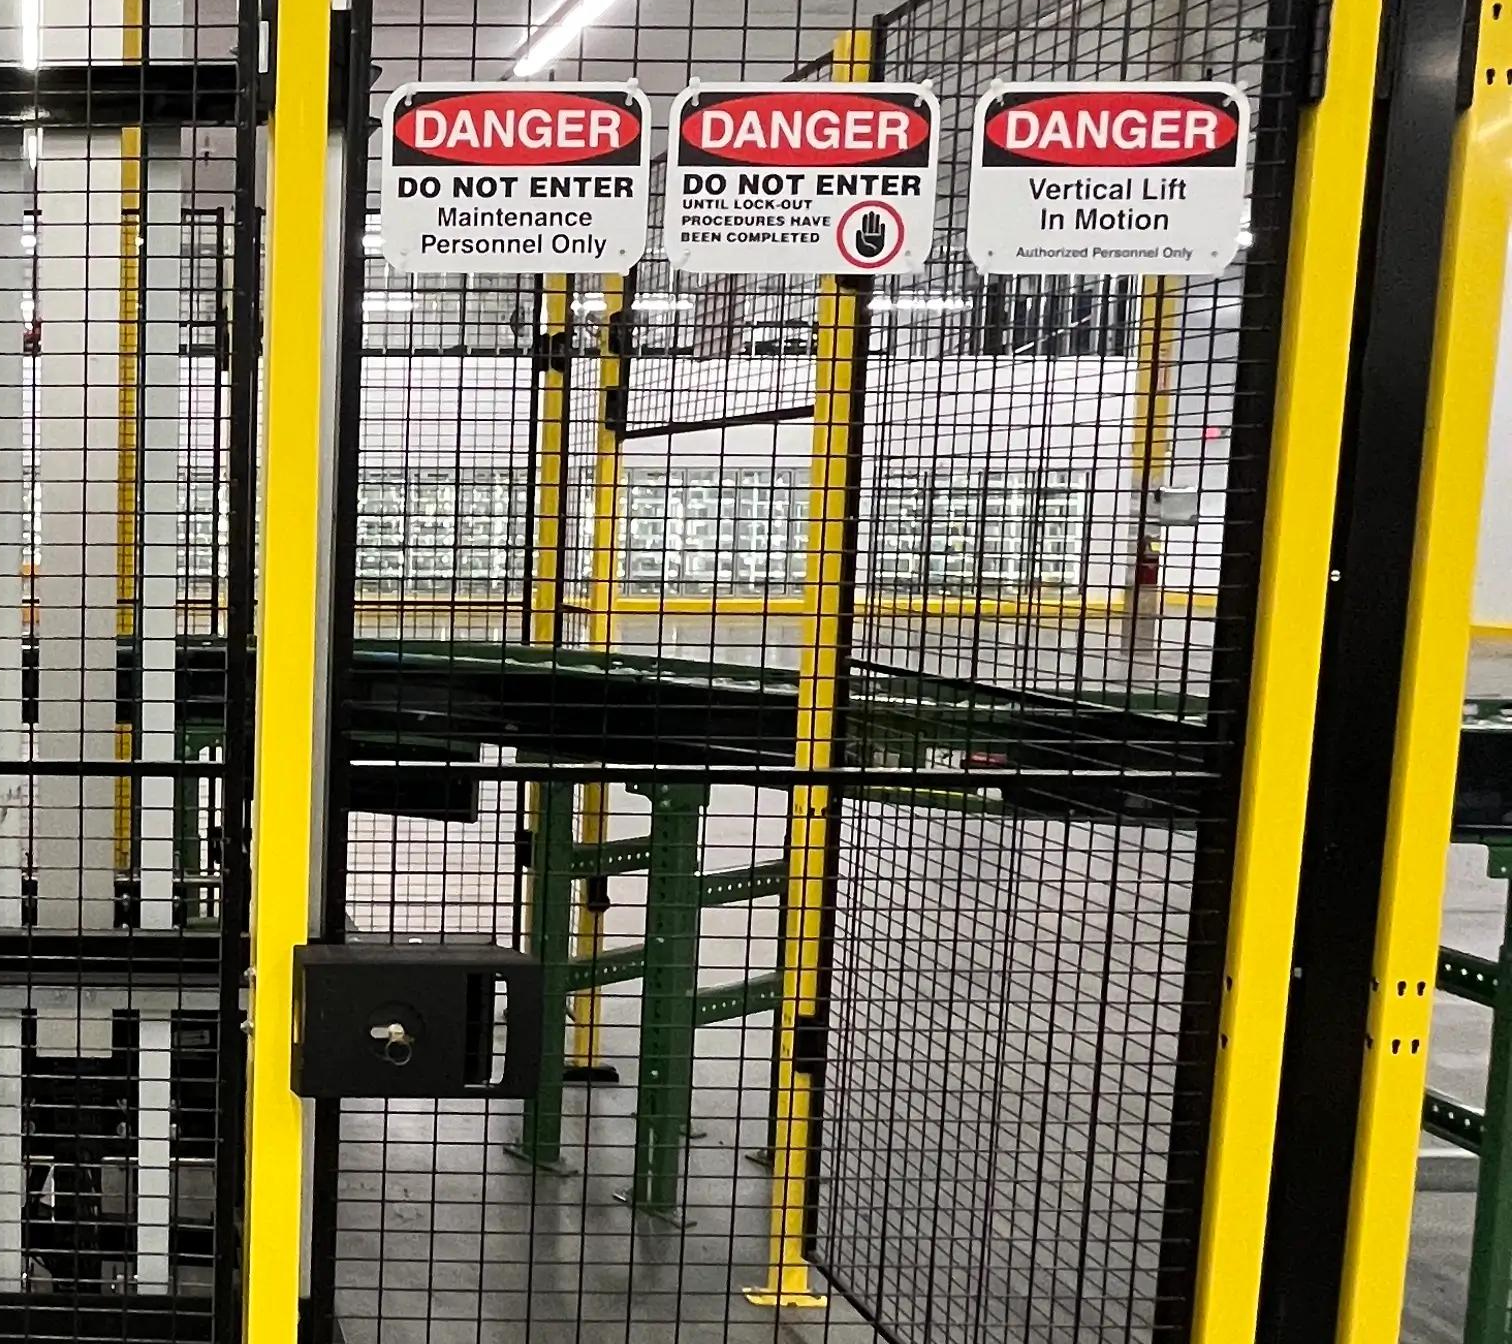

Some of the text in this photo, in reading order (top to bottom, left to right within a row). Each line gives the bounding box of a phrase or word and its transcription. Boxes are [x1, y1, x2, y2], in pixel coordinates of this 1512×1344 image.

[413, 108, 622, 149] DANGER
[700, 109, 911, 150] DANGER
[1005, 109, 1219, 150] DANGER
[397, 176, 634, 199] DO NOT ENTER
[682, 173, 922, 197] DO NOT ENTER
[1028, 177, 1188, 201] Vertical Lift
[682, 198, 814, 211] UNTIL LOCK-OUT
[437, 206, 593, 228] Maintenance
[681, 215, 832, 227] PROCEDURES HAVE
[1039, 207, 1170, 231] In Motion
[420, 233, 608, 260] Personnel Only
[680, 231, 821, 244] BEEN COMPLETED
[1015, 246, 1194, 262] Authorized Personnel Only
